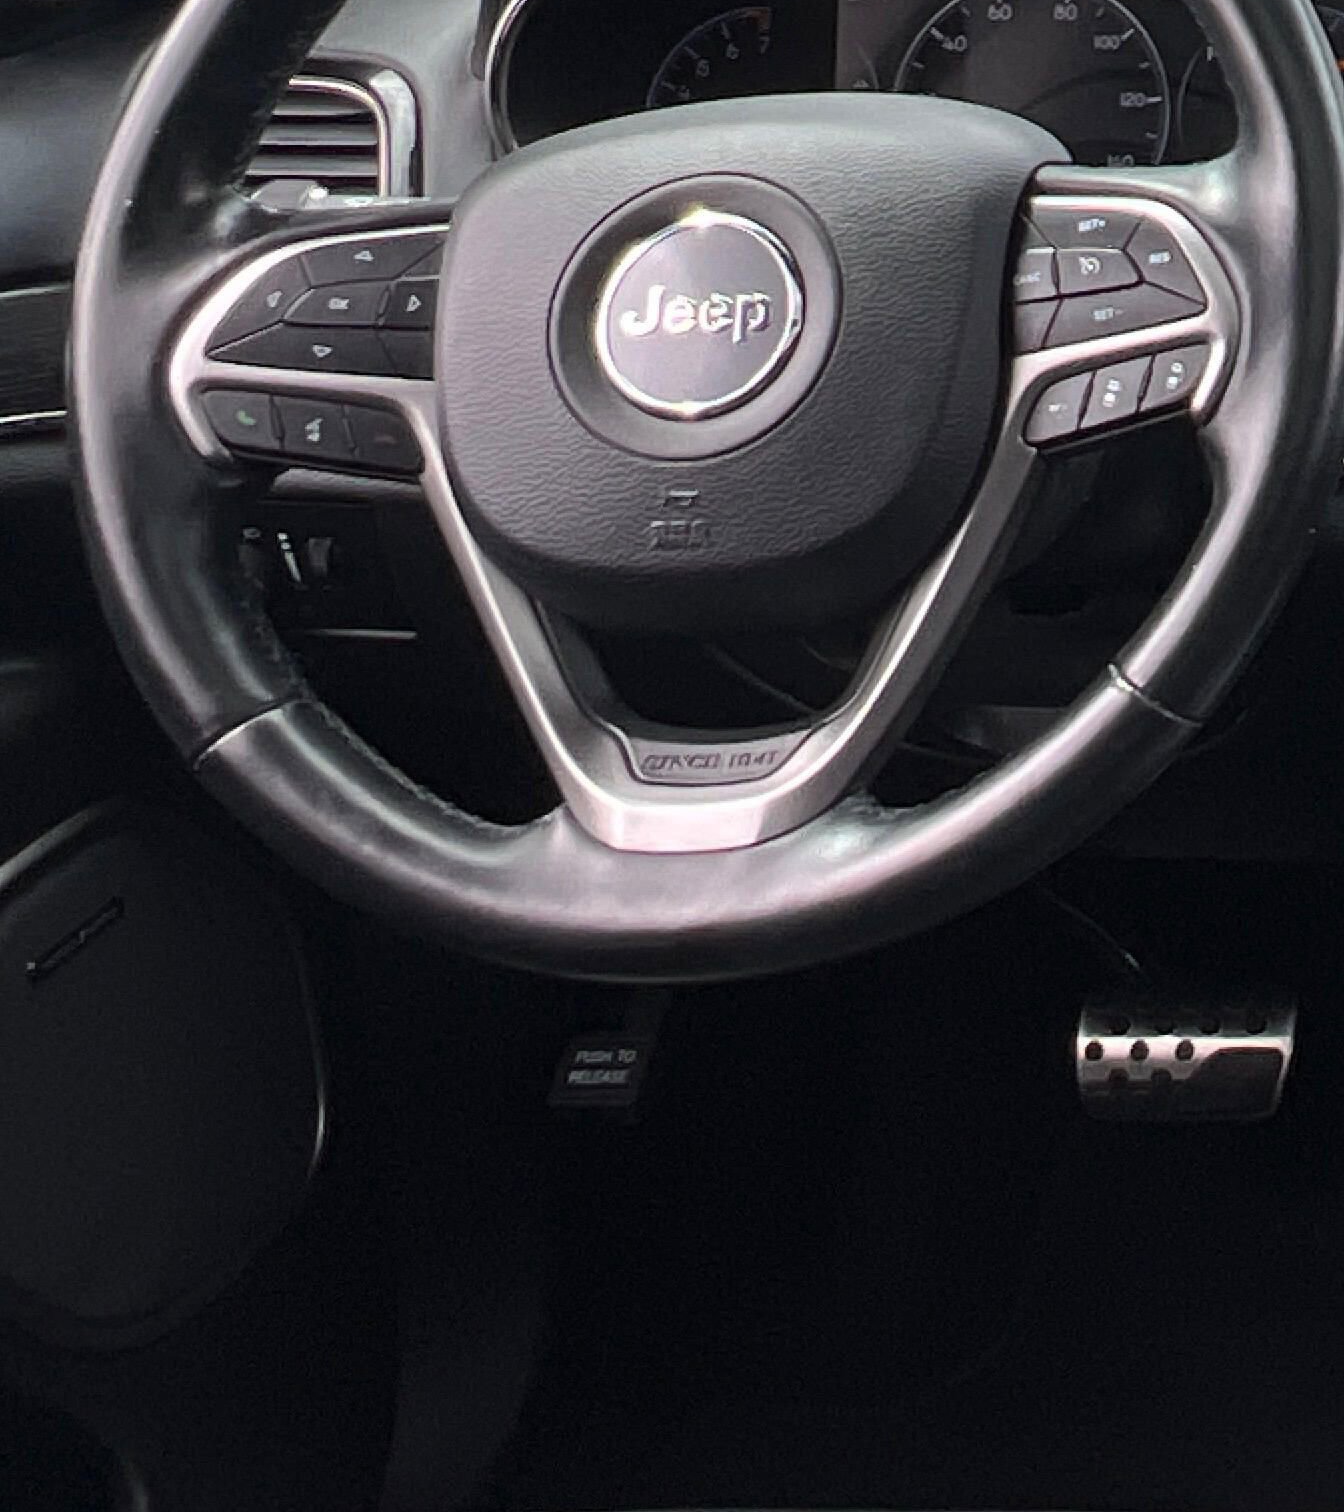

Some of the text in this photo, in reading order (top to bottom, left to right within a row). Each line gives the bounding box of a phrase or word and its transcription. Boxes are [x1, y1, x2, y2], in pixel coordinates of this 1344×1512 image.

[987, 3, 1079, 22] 60 80
[942, 36, 968, 53] 40
[620, 285, 772, 345] Jeep
